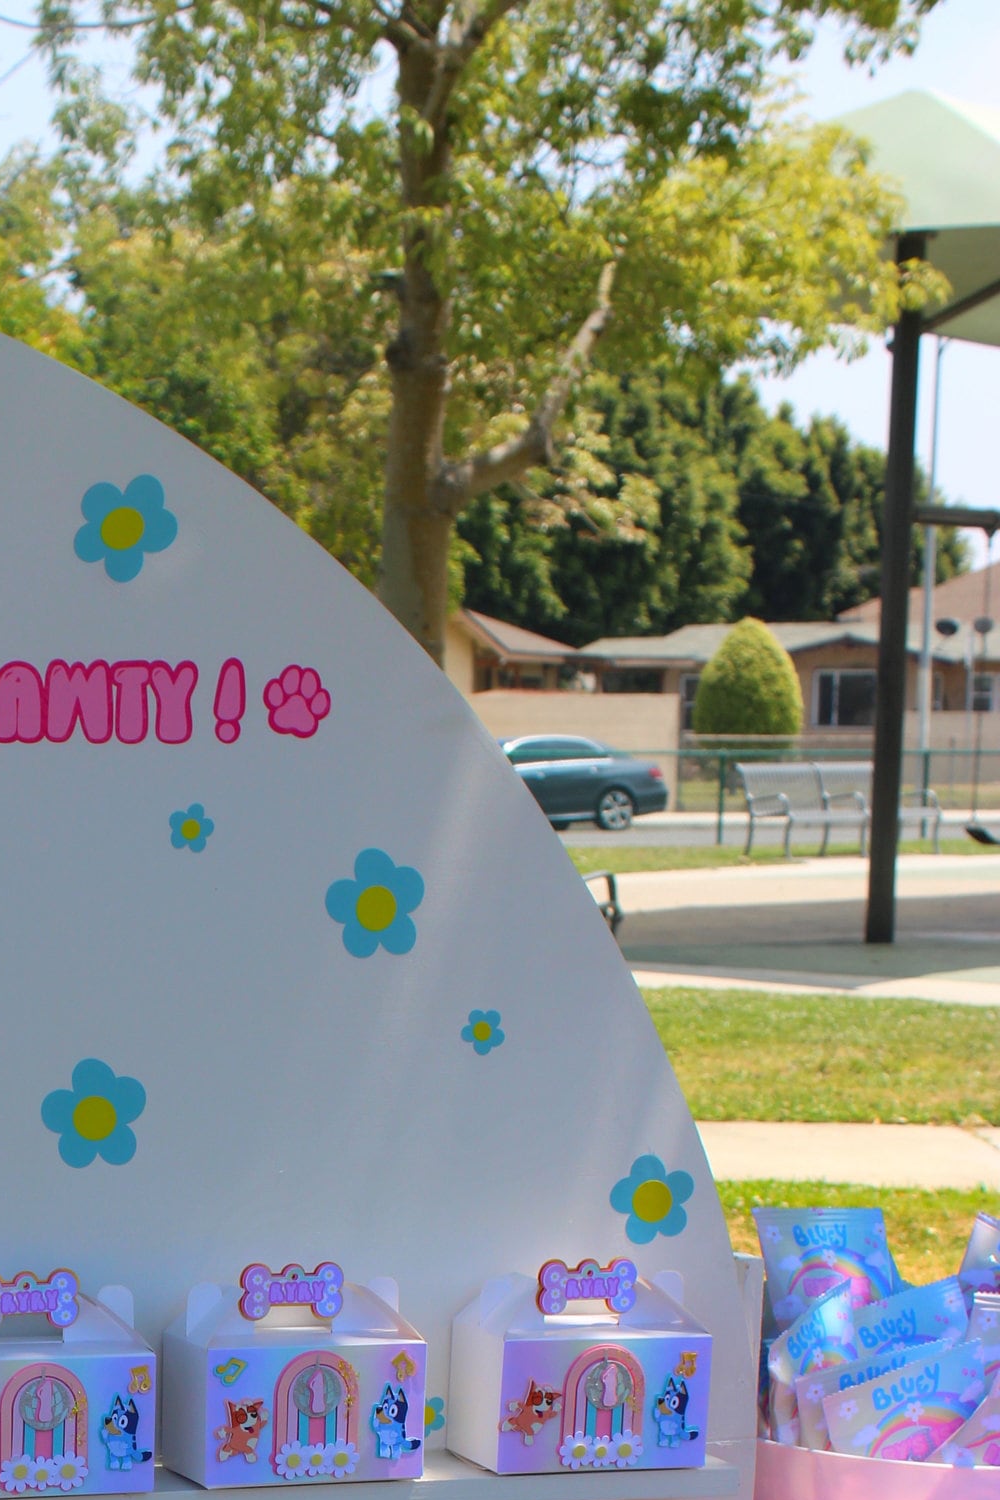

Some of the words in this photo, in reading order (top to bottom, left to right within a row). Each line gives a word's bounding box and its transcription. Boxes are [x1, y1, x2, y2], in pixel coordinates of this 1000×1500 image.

[792, 1224, 848, 1247] BLUEY
[858, 1308, 916, 1348] BLUEY
[872, 1362, 941, 1411] BLUEY
